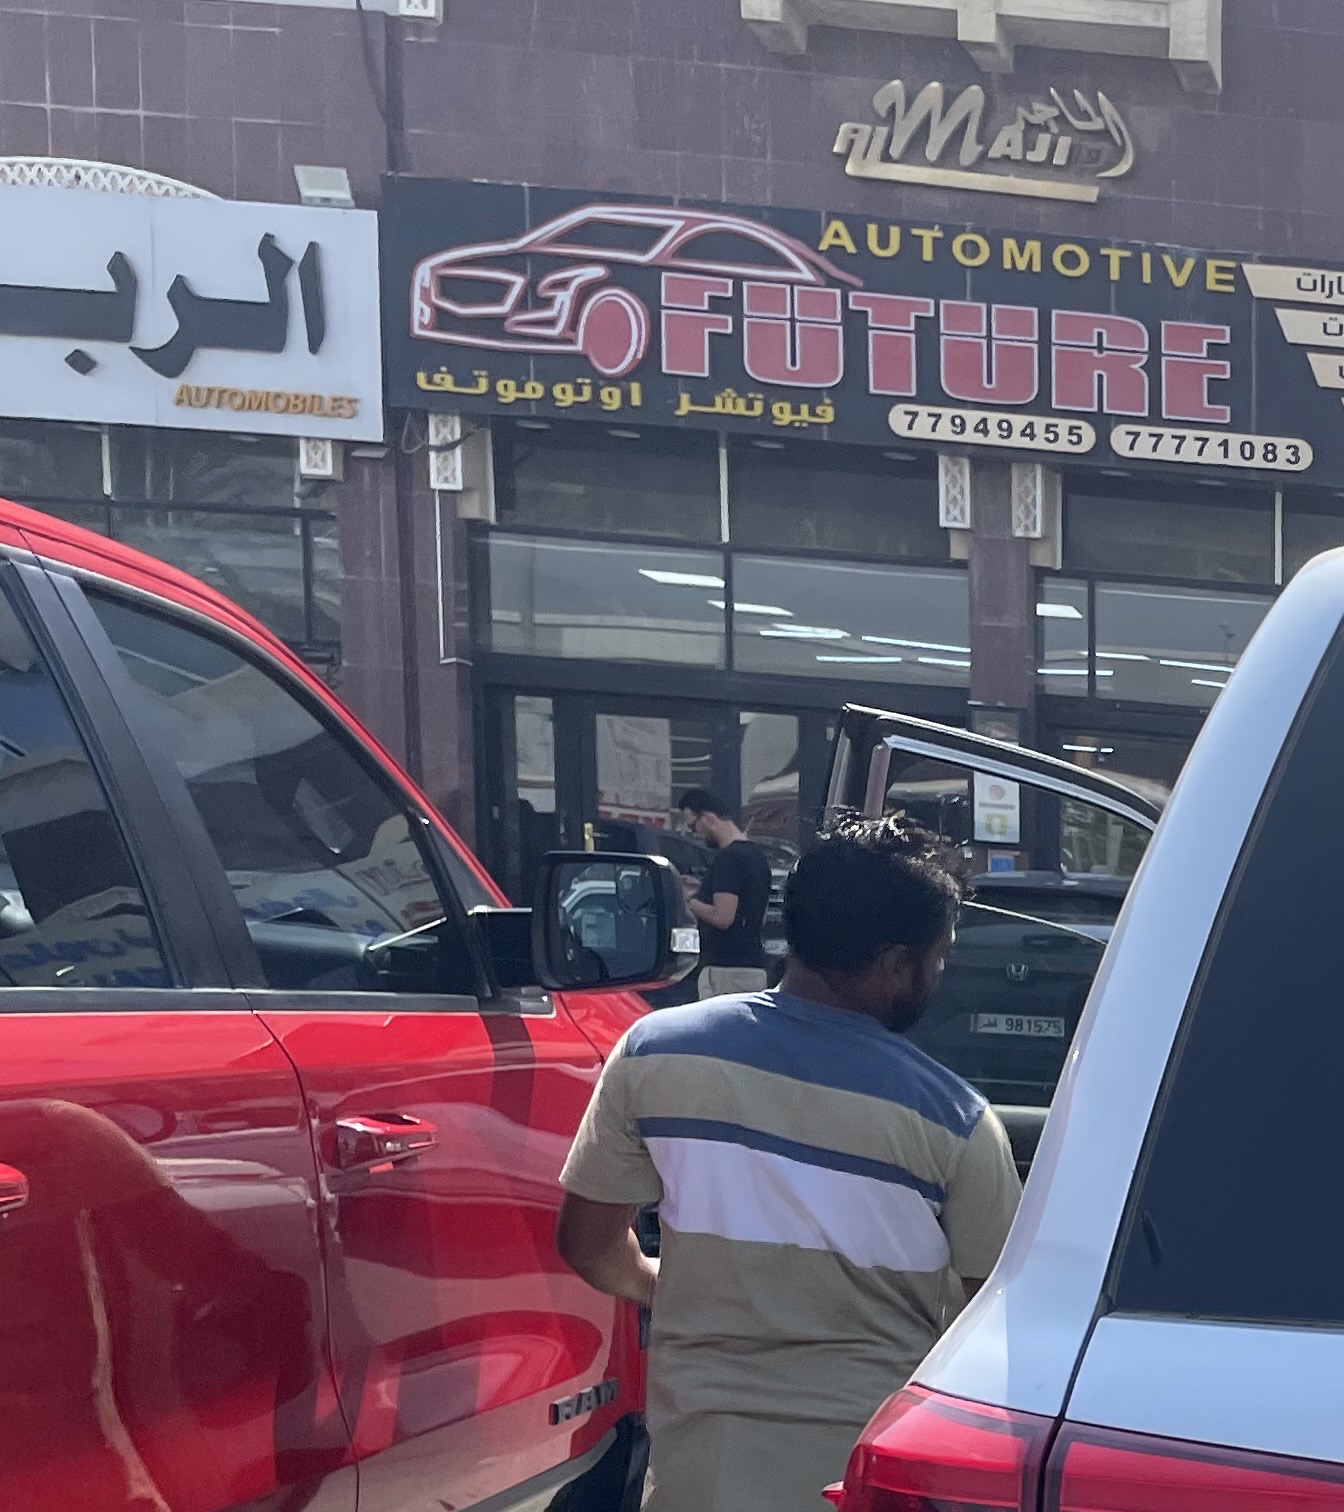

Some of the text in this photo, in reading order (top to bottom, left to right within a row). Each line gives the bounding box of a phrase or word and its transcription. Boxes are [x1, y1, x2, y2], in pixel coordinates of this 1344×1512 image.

[818, 219, 1237, 294] AUTOMOTIVE
[660, 272, 1232, 424] FUTURE
[172, 384, 360, 420] AUTOMOBILES
[414, 365, 836, 427] فيوتشر اوتوموتف
[902, 409, 1085, 448] 77949455
[1123, 430, 1303, 468] 77771083
[548, 1377, 620, 1426] RAM
